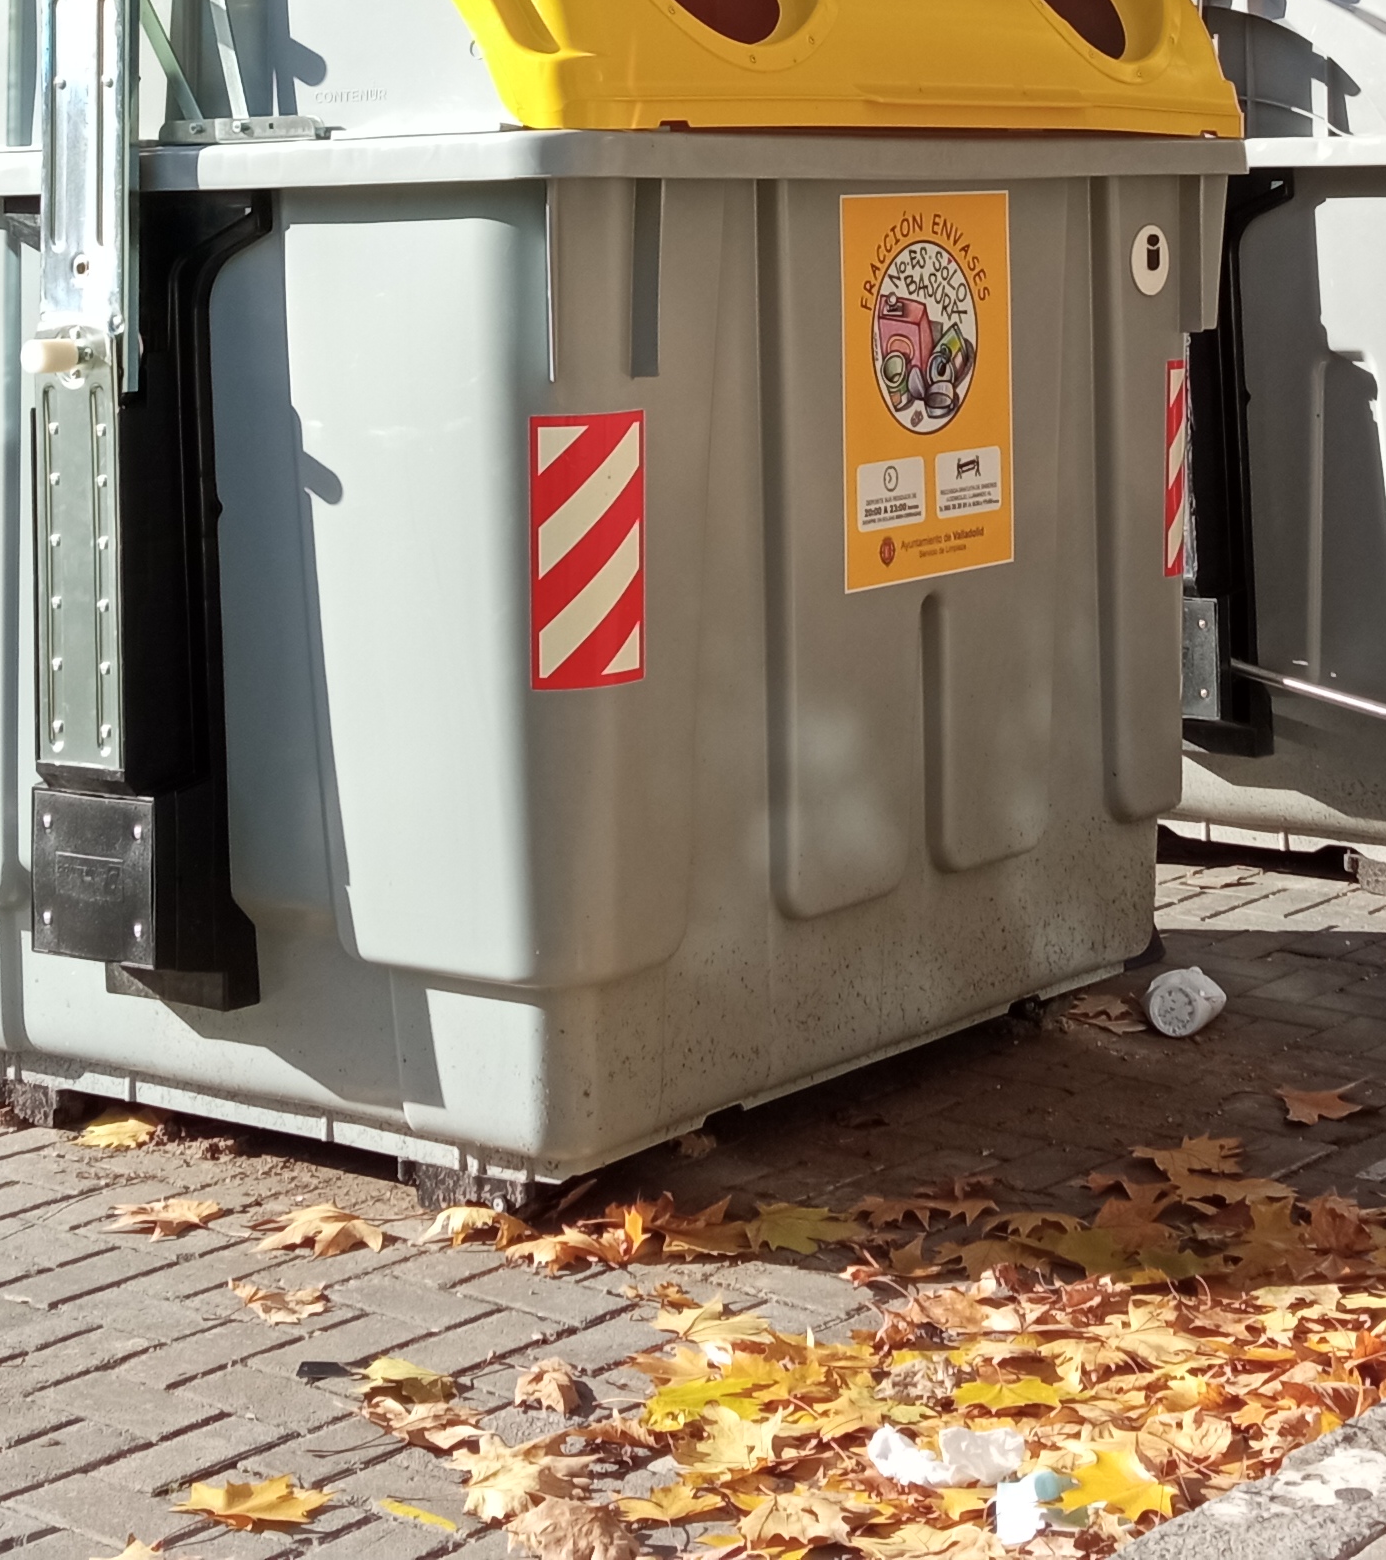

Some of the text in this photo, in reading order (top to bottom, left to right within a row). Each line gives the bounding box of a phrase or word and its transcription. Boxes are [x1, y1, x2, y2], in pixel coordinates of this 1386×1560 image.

[315, 88, 388, 104] CONTENUR
[860, 211, 990, 311] FRACCIÓN ENVASES
[904, 272, 967, 324] BASURA
[901, 527, 984, 552] Ayuntamiento de Valladolid
